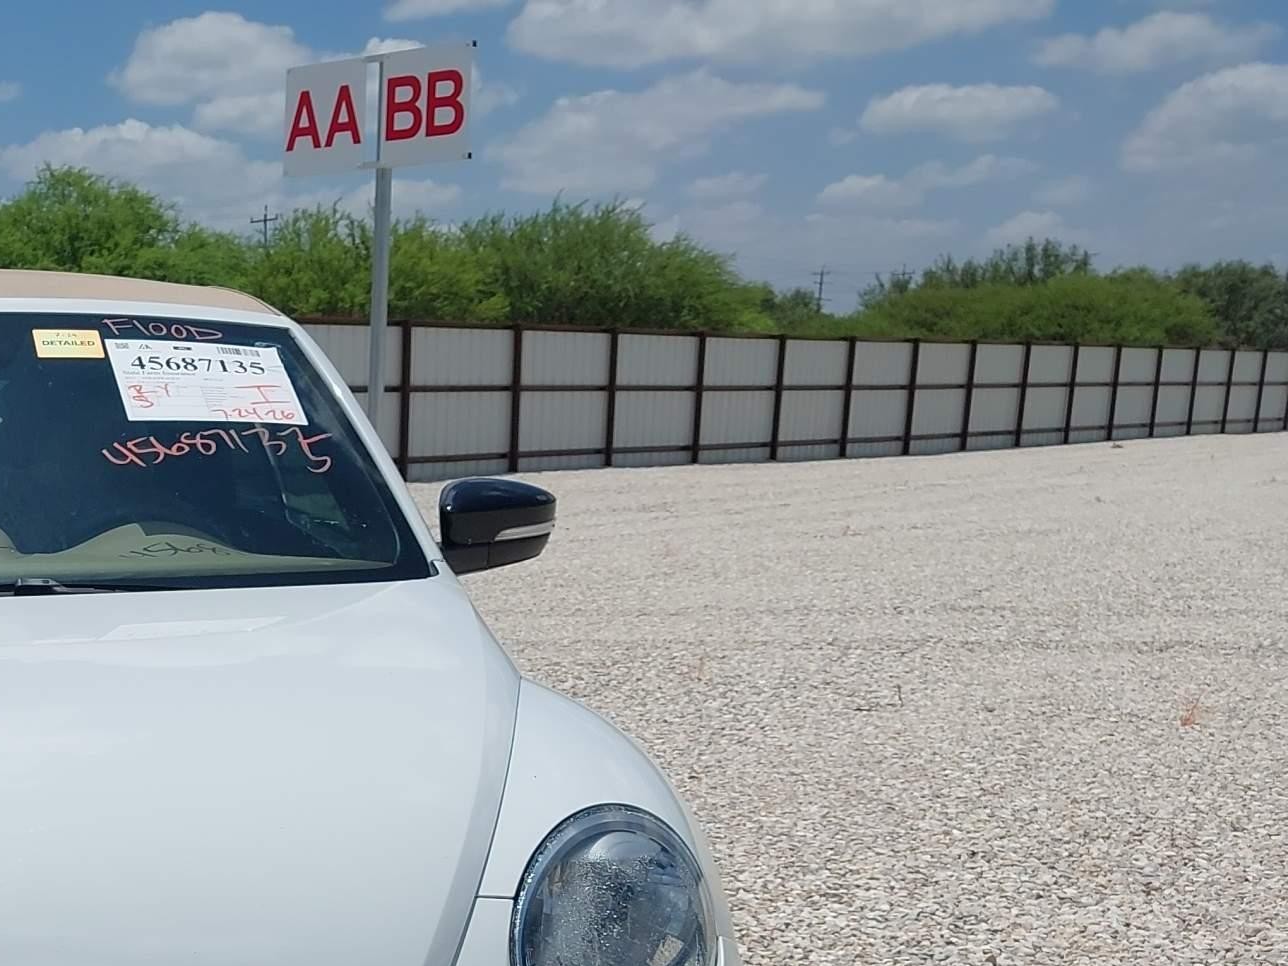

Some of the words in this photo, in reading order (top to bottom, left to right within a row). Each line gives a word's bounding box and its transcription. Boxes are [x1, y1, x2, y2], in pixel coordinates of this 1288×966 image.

[285, 84, 361, 152] AA
[385, 69, 465, 141] BB
[130, 355, 265, 375] 45687135
